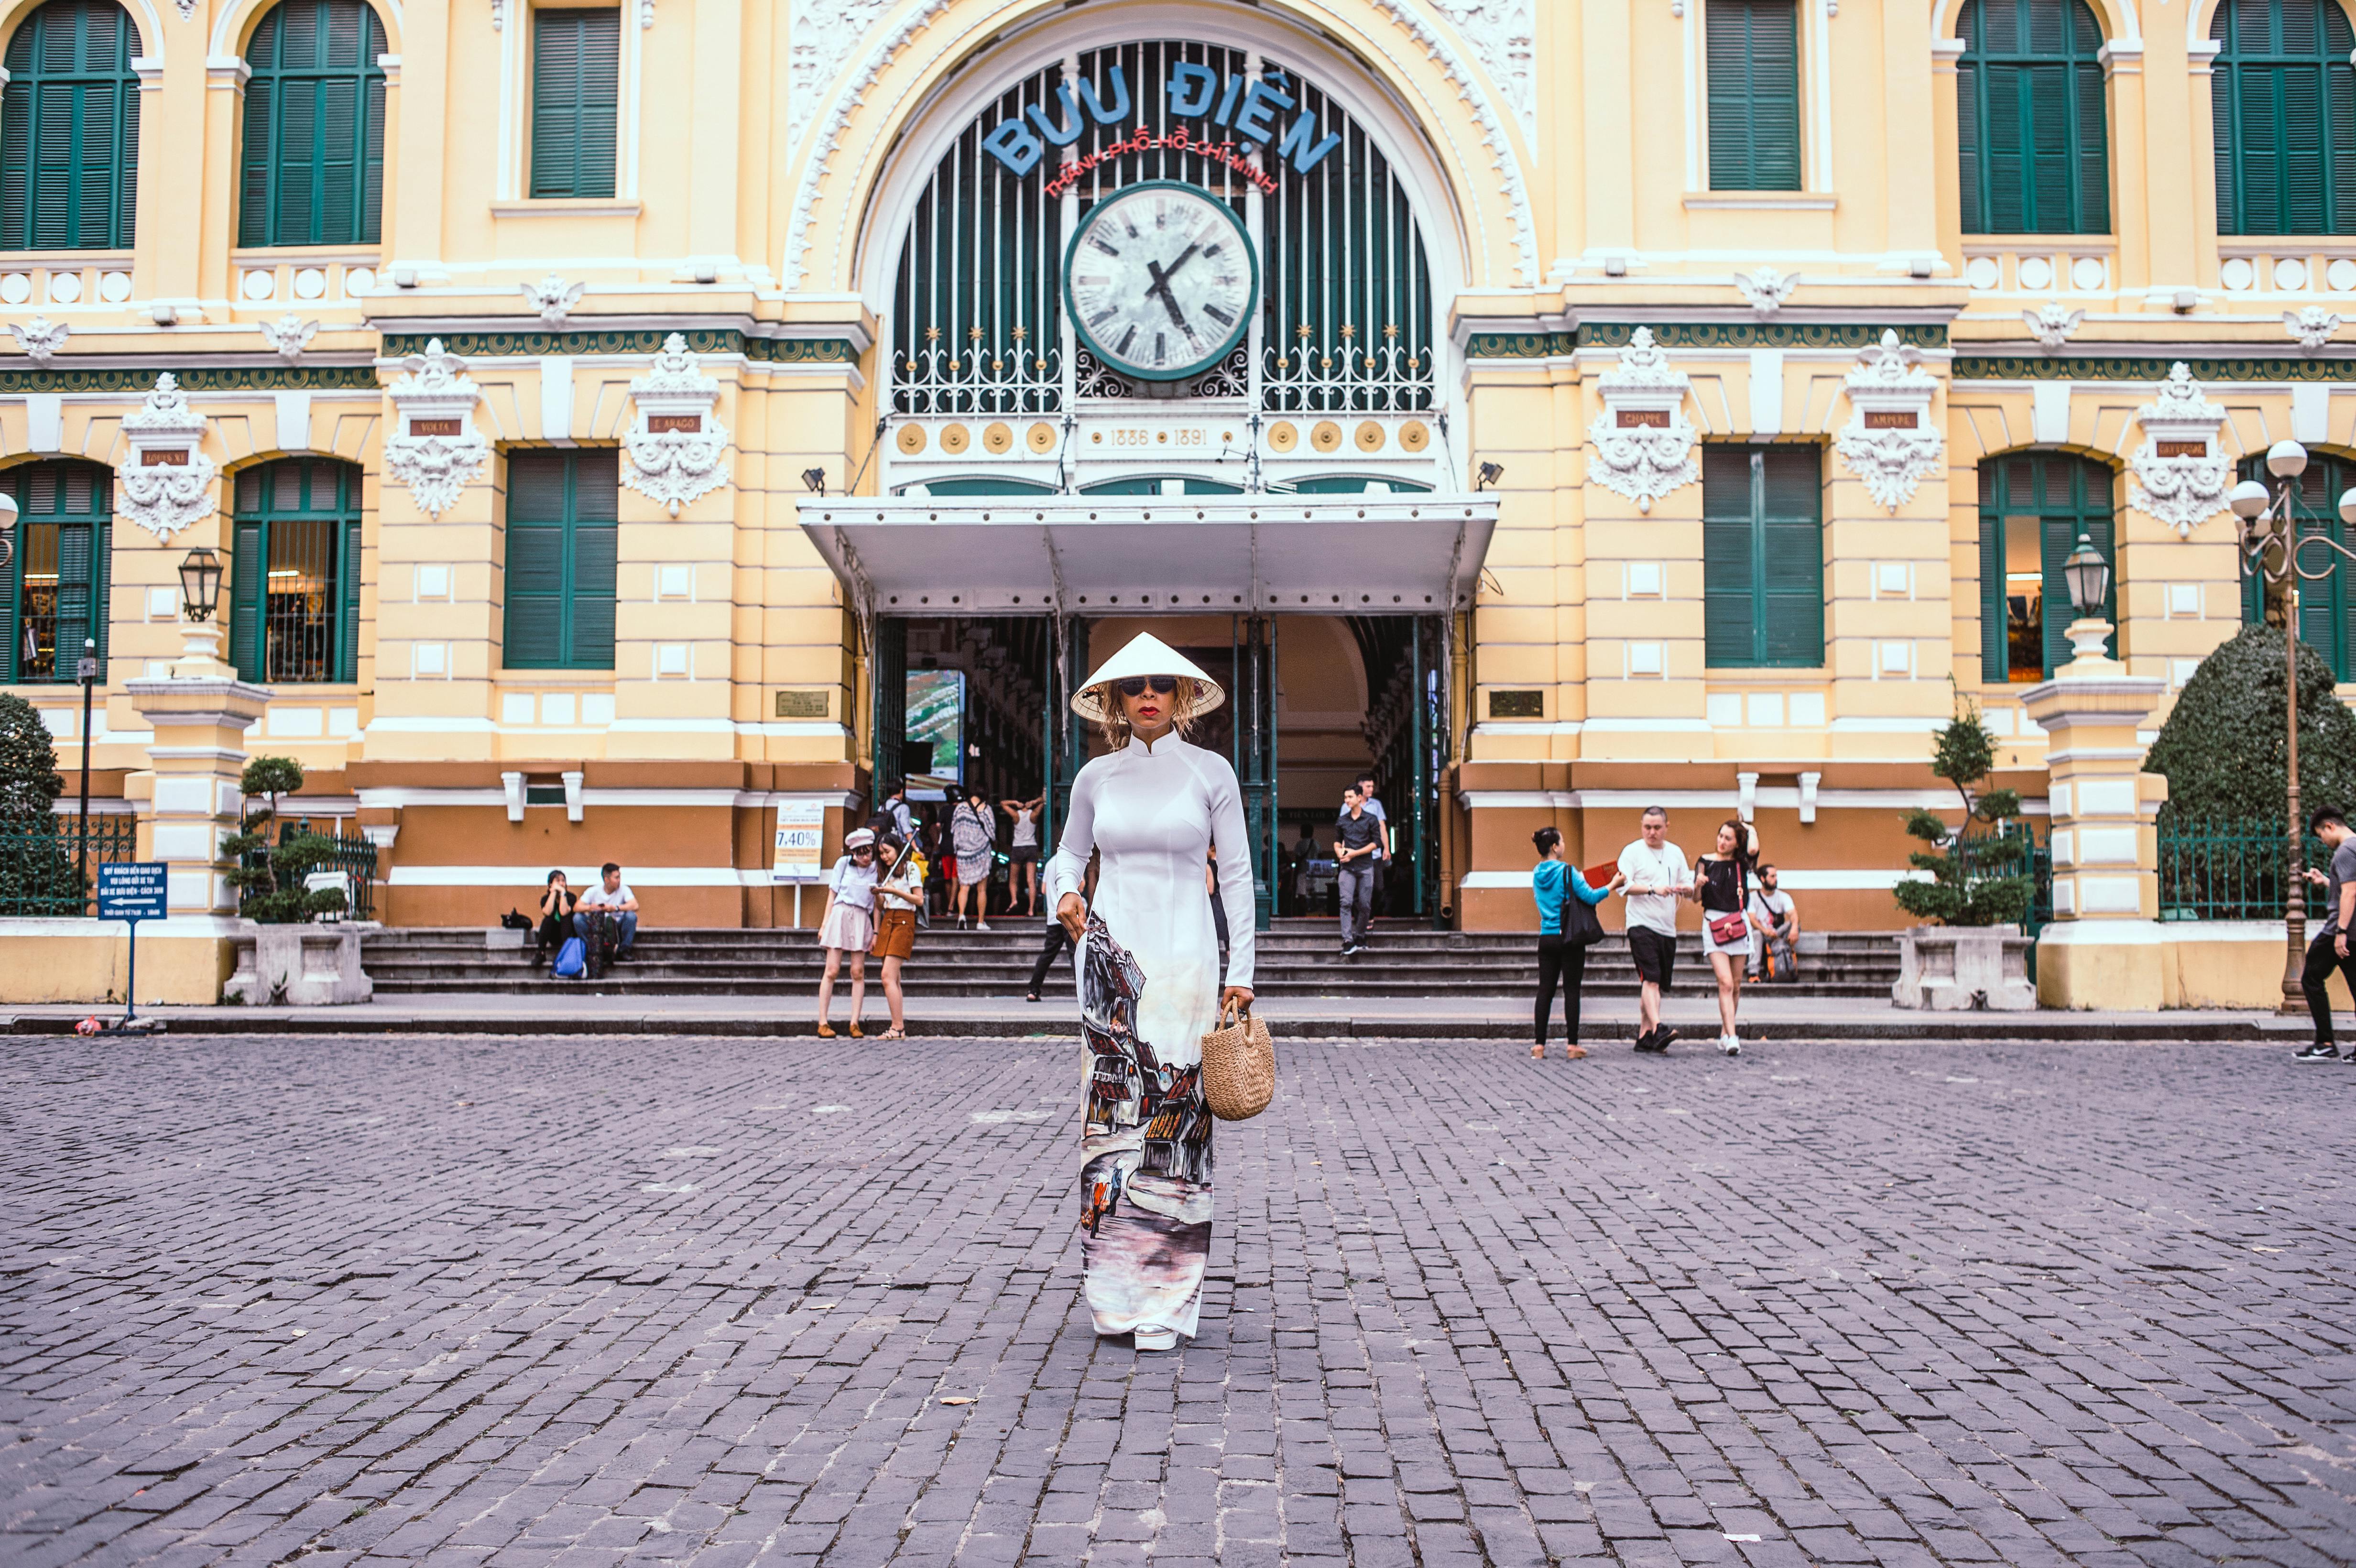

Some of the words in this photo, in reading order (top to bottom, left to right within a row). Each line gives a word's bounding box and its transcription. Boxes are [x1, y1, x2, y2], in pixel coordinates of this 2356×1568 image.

[982, 65, 1131, 178] BƯU
[1166, 60, 1342, 175] ĐIỆN
[1044, 148, 1106, 197] THÀNH
[1194, 141, 1235, 163] CHÍ
[1231, 153, 1278, 194] MINH
[421, 422, 449, 433] VOLTA
[665, 418, 695, 429] ARAGO
[1111, 429, 1148, 446] 1886
[1175, 429, 1207, 446] 1891
[146, 453, 173, 464] LOUIS
[778, 831, 816, 847] 7,40%
[109, 887, 115, 895] XE
